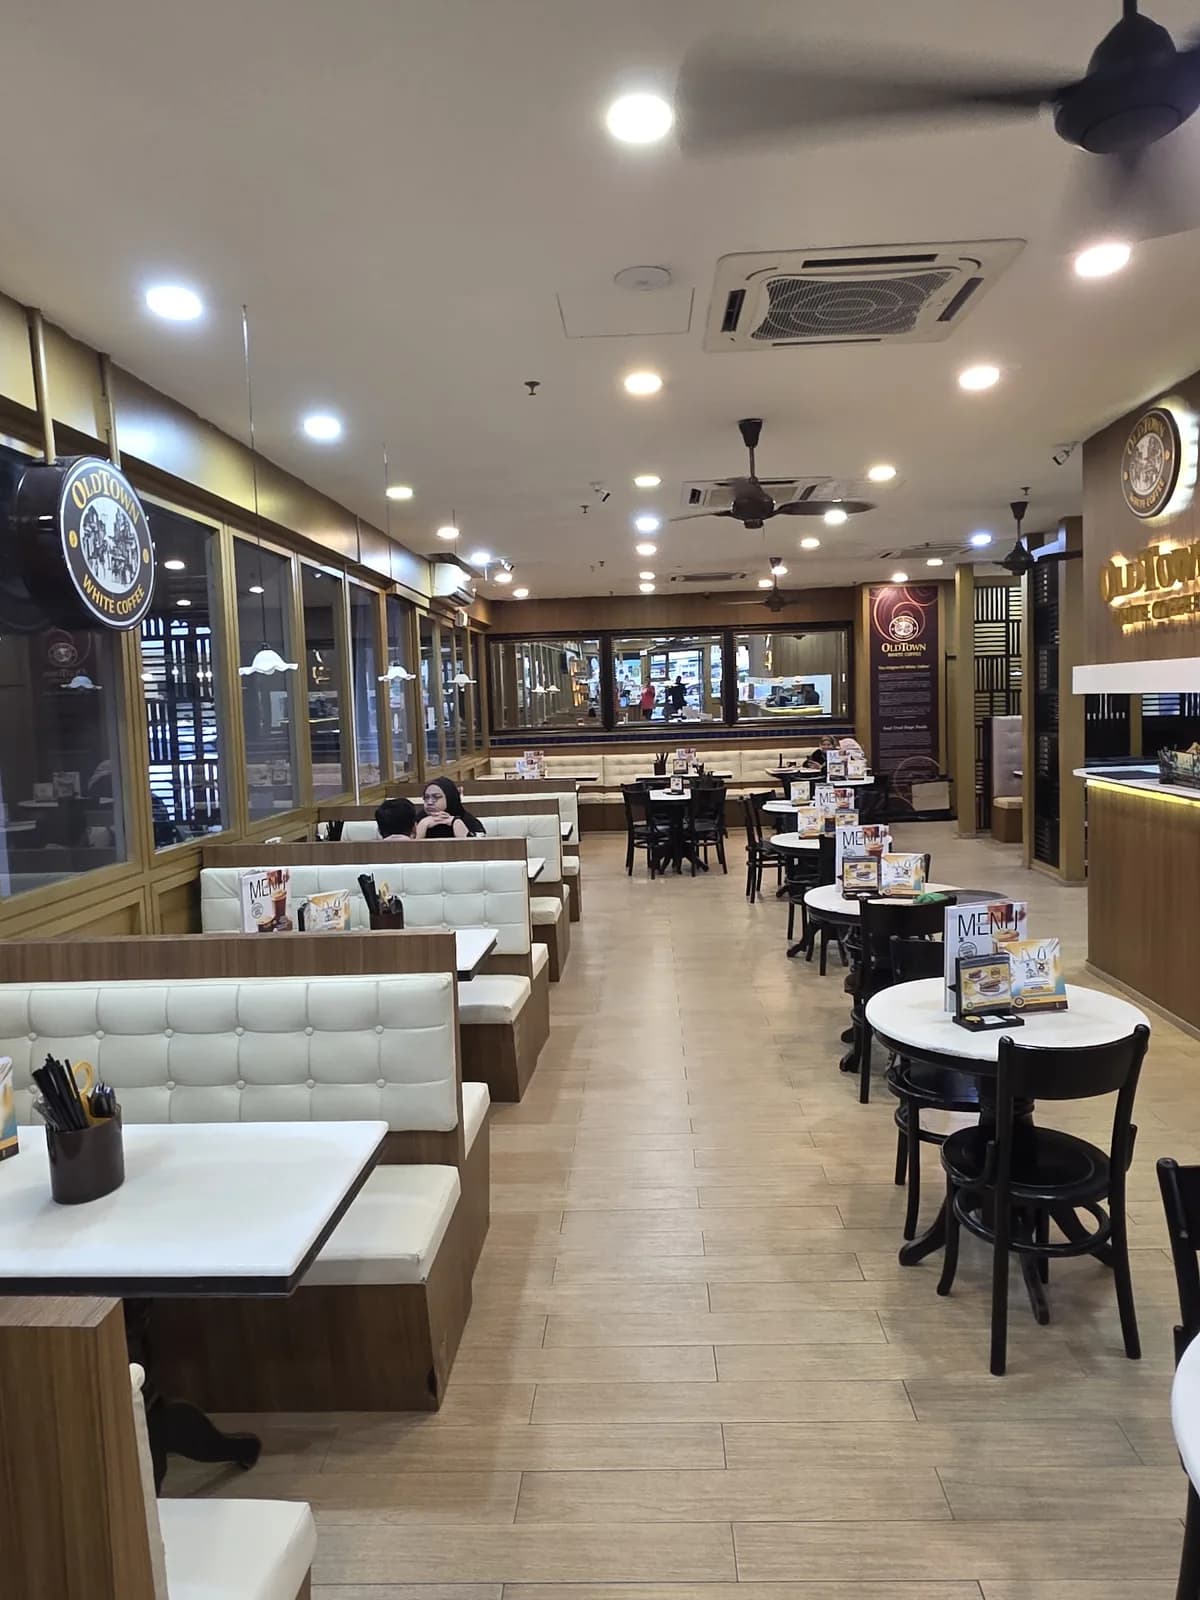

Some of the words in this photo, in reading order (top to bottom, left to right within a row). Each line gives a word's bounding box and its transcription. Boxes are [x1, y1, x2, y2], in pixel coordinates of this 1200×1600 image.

[72, 471, 140, 524] OLDTOWN
[82, 574, 115, 613] WHITE
[116, 584, 145, 614] COFFEE
[881, 643, 926, 653] OLDTOWN
[842, 831, 884, 846] MENU
[957, 910, 1018, 937] MENU
